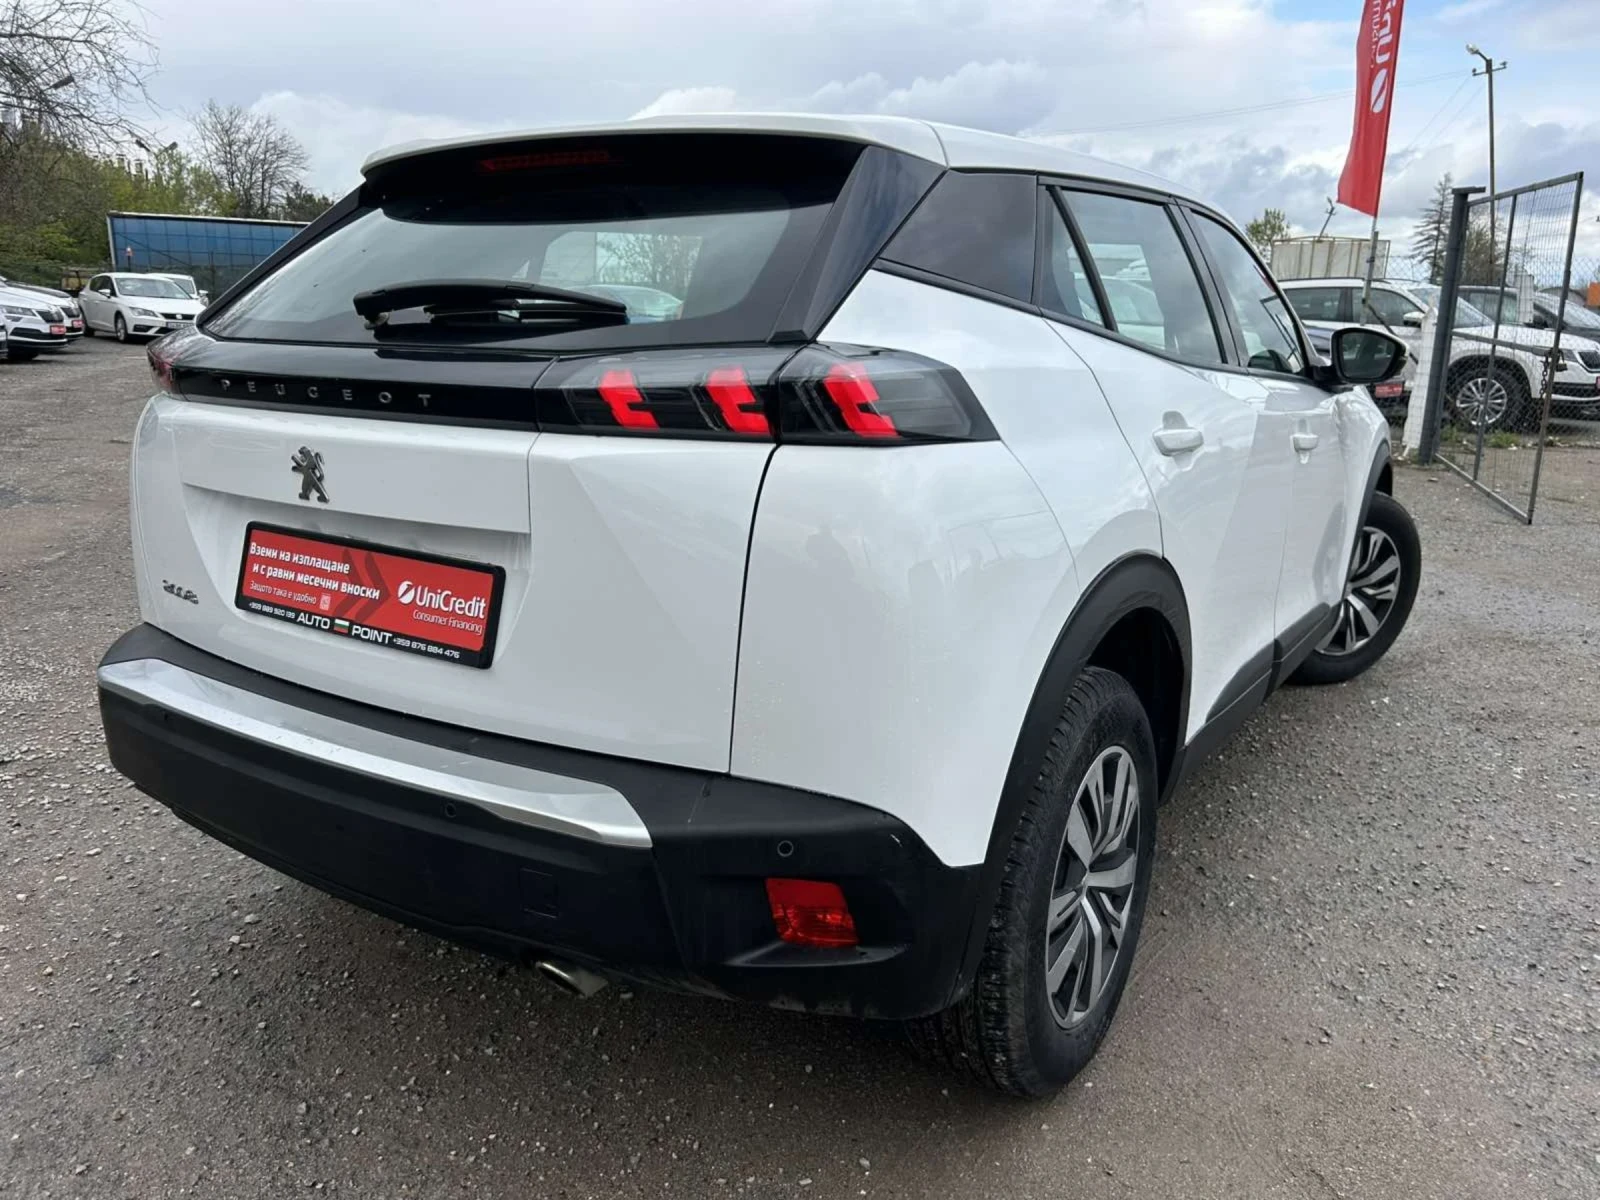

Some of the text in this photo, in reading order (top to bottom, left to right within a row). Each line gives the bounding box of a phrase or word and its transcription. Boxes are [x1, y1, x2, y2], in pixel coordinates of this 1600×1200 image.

[220, 379, 431, 407] PEUGEOT
[249, 542, 350, 574] Вземи на изплащане
[252, 563, 259, 573] и
[266, 566, 295, 581] равни
[296, 573, 339, 591] месечни
[341, 583, 380, 600] вноски
[416, 585, 486, 619] UniCredit
[297, 612, 330, 630] AUTO
[351, 625, 392, 645] POINT
[444, 649, 460, 659] 476
[412, 609, 483, 636] Consumer Financing
